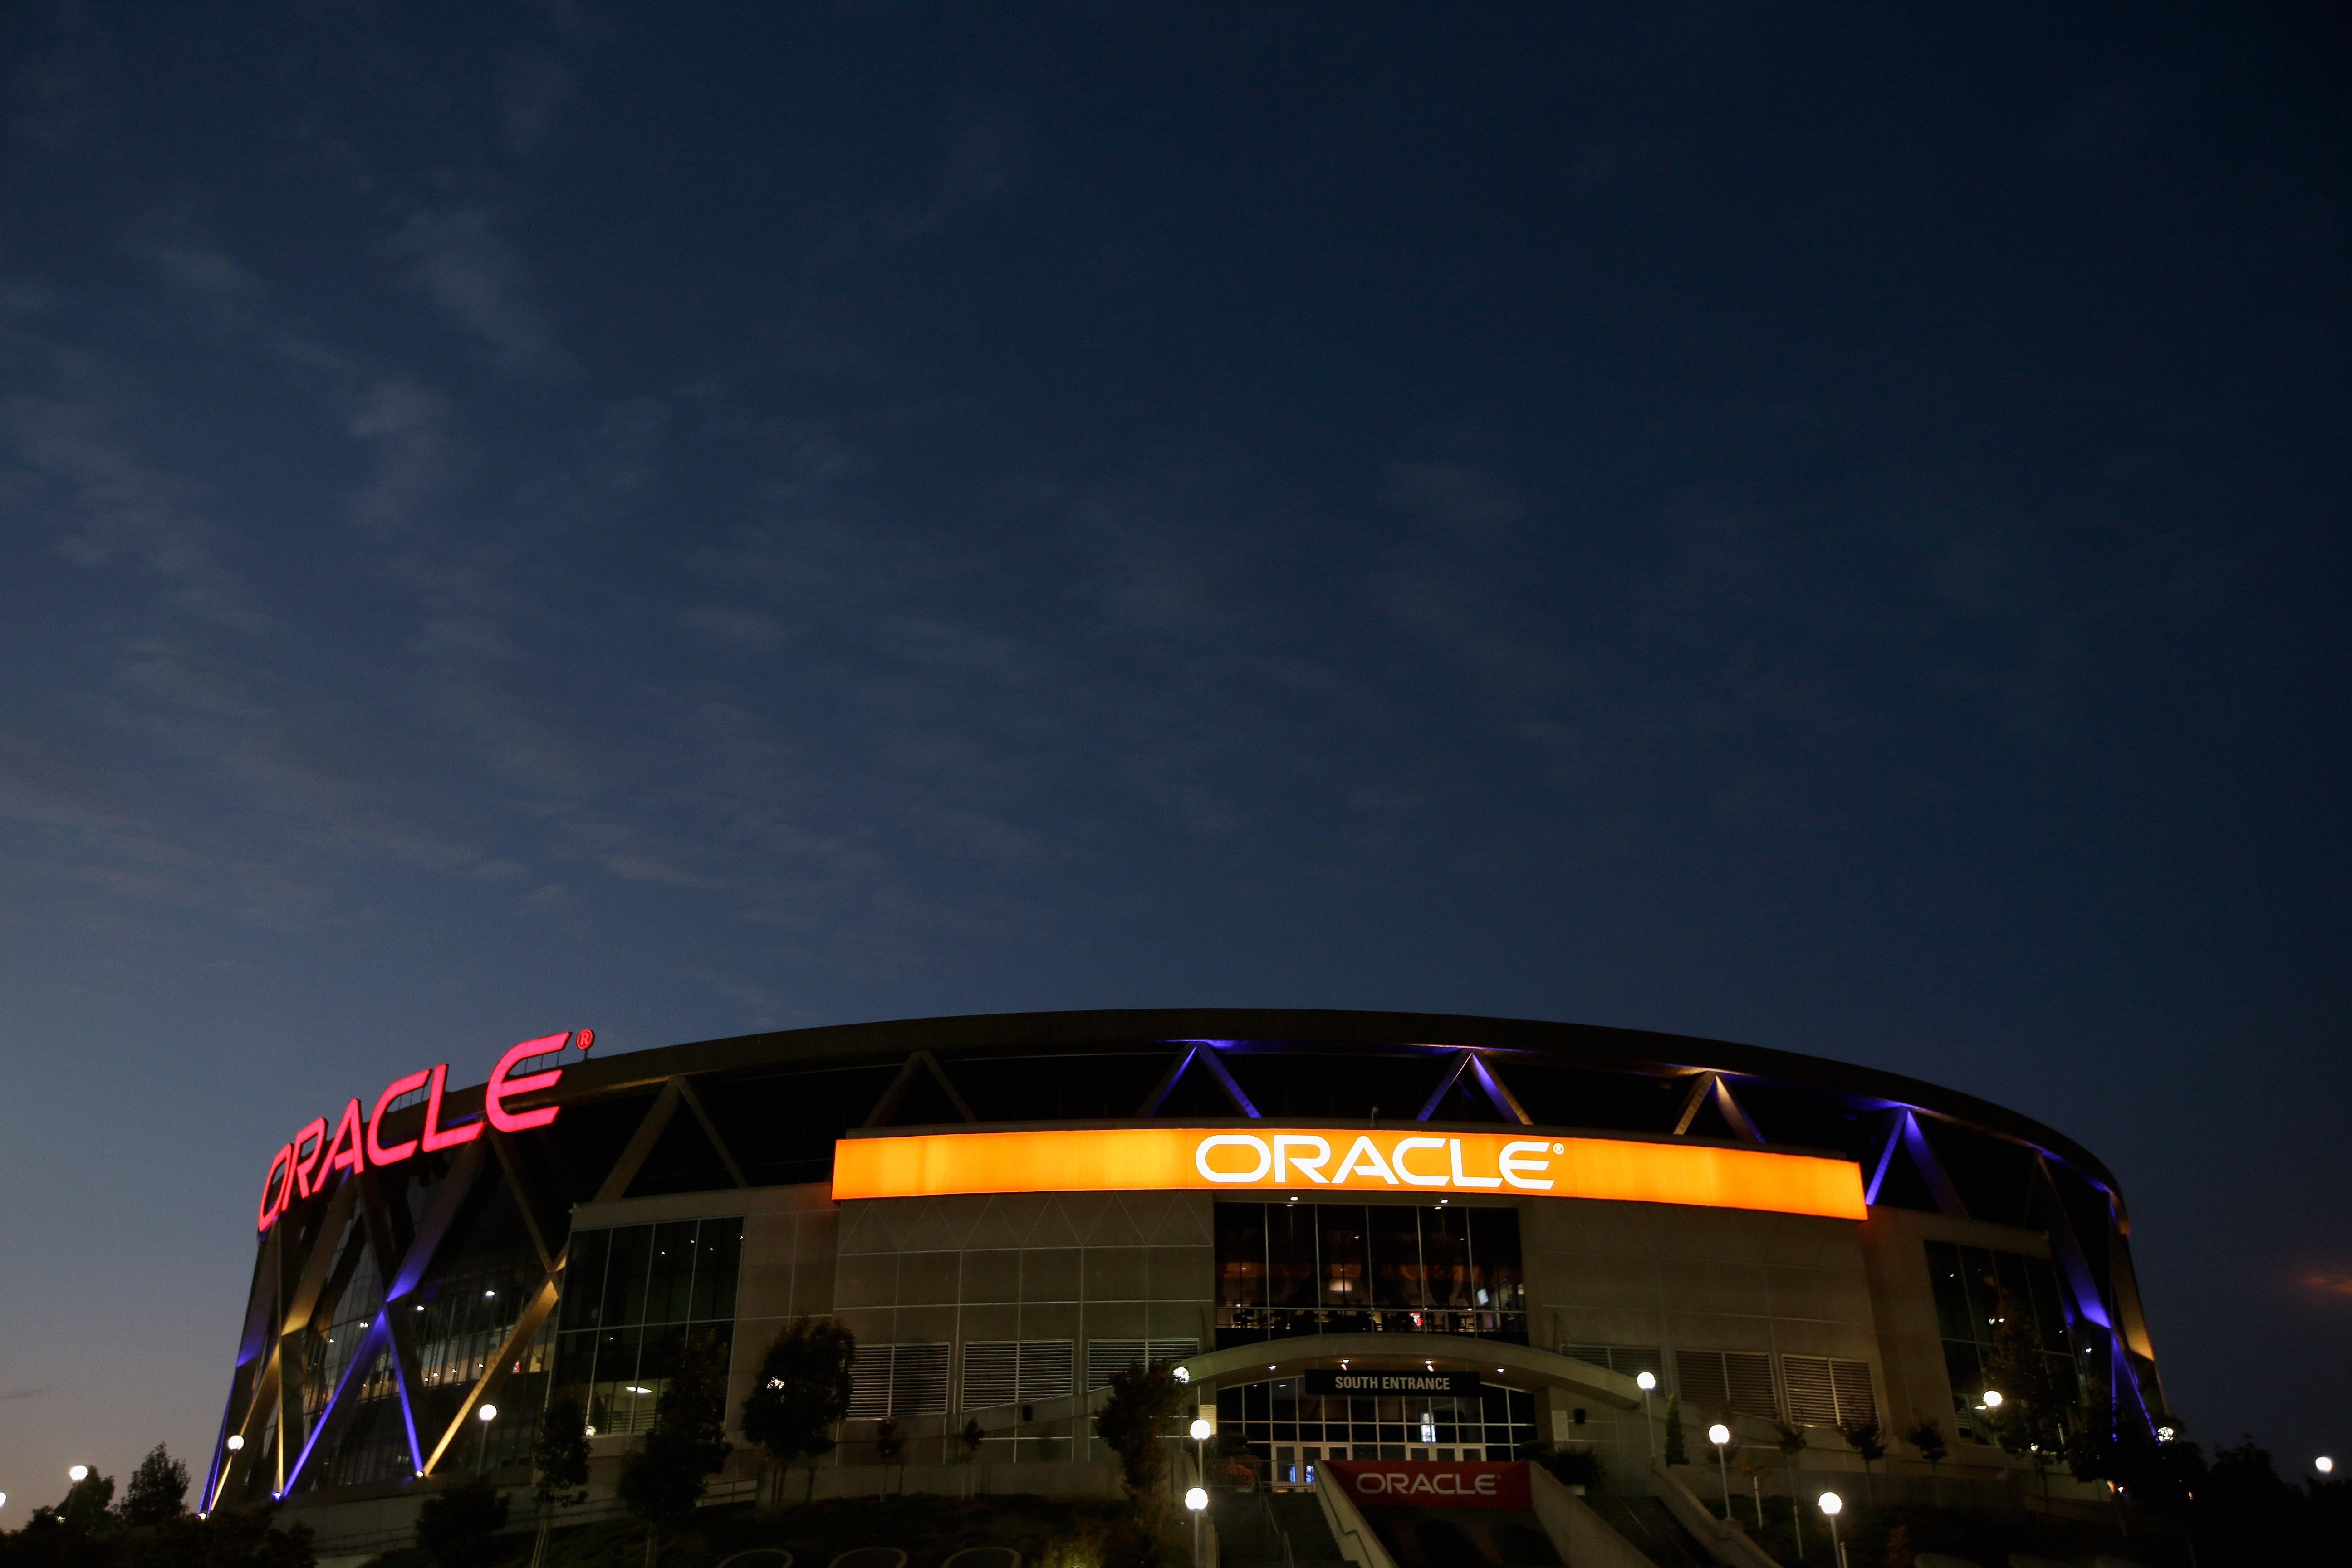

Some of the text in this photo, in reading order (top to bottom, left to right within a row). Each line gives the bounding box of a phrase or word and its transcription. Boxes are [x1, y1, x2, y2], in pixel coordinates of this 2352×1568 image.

[258, 1031, 573, 1232] ORACLE
[1195, 1134, 1555, 1190] ORACLE
[1335, 1375, 1451, 1390] SOUTH ENTRANCE
[1356, 1473, 1498, 1495] ORACLE
